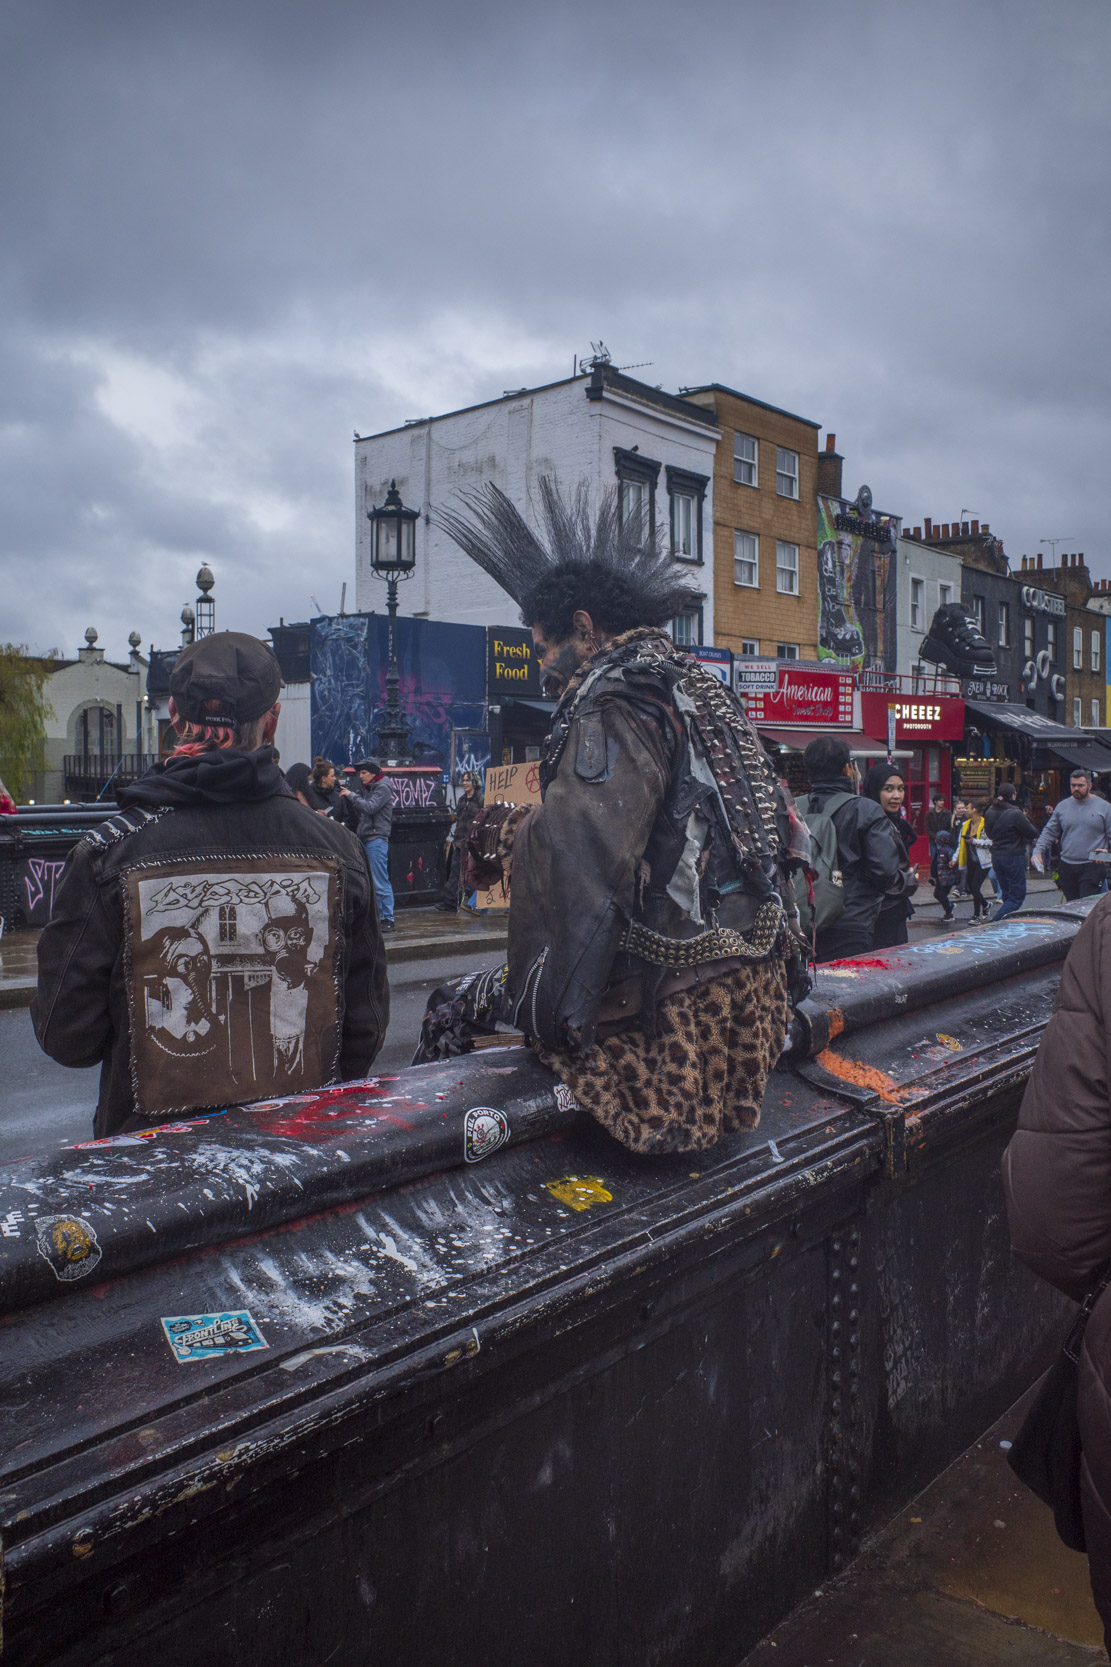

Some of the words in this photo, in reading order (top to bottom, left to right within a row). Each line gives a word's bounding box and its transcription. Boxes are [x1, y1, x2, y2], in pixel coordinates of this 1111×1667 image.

[493, 640, 530, 659] Fresh
[495, 662, 528, 680] Food
[741, 672, 775, 683] TOBACCO
[770, 673, 833, 709] American
[792, 704, 814, 716] Sweet
[815, 704, 834, 720] Shop
[894, 703, 941, 720] CHEEEZ
[489, 766, 519, 793] HELP
[467, 1117, 475, 1137] FIEL
[472, 1110, 501, 1122] PORTO
